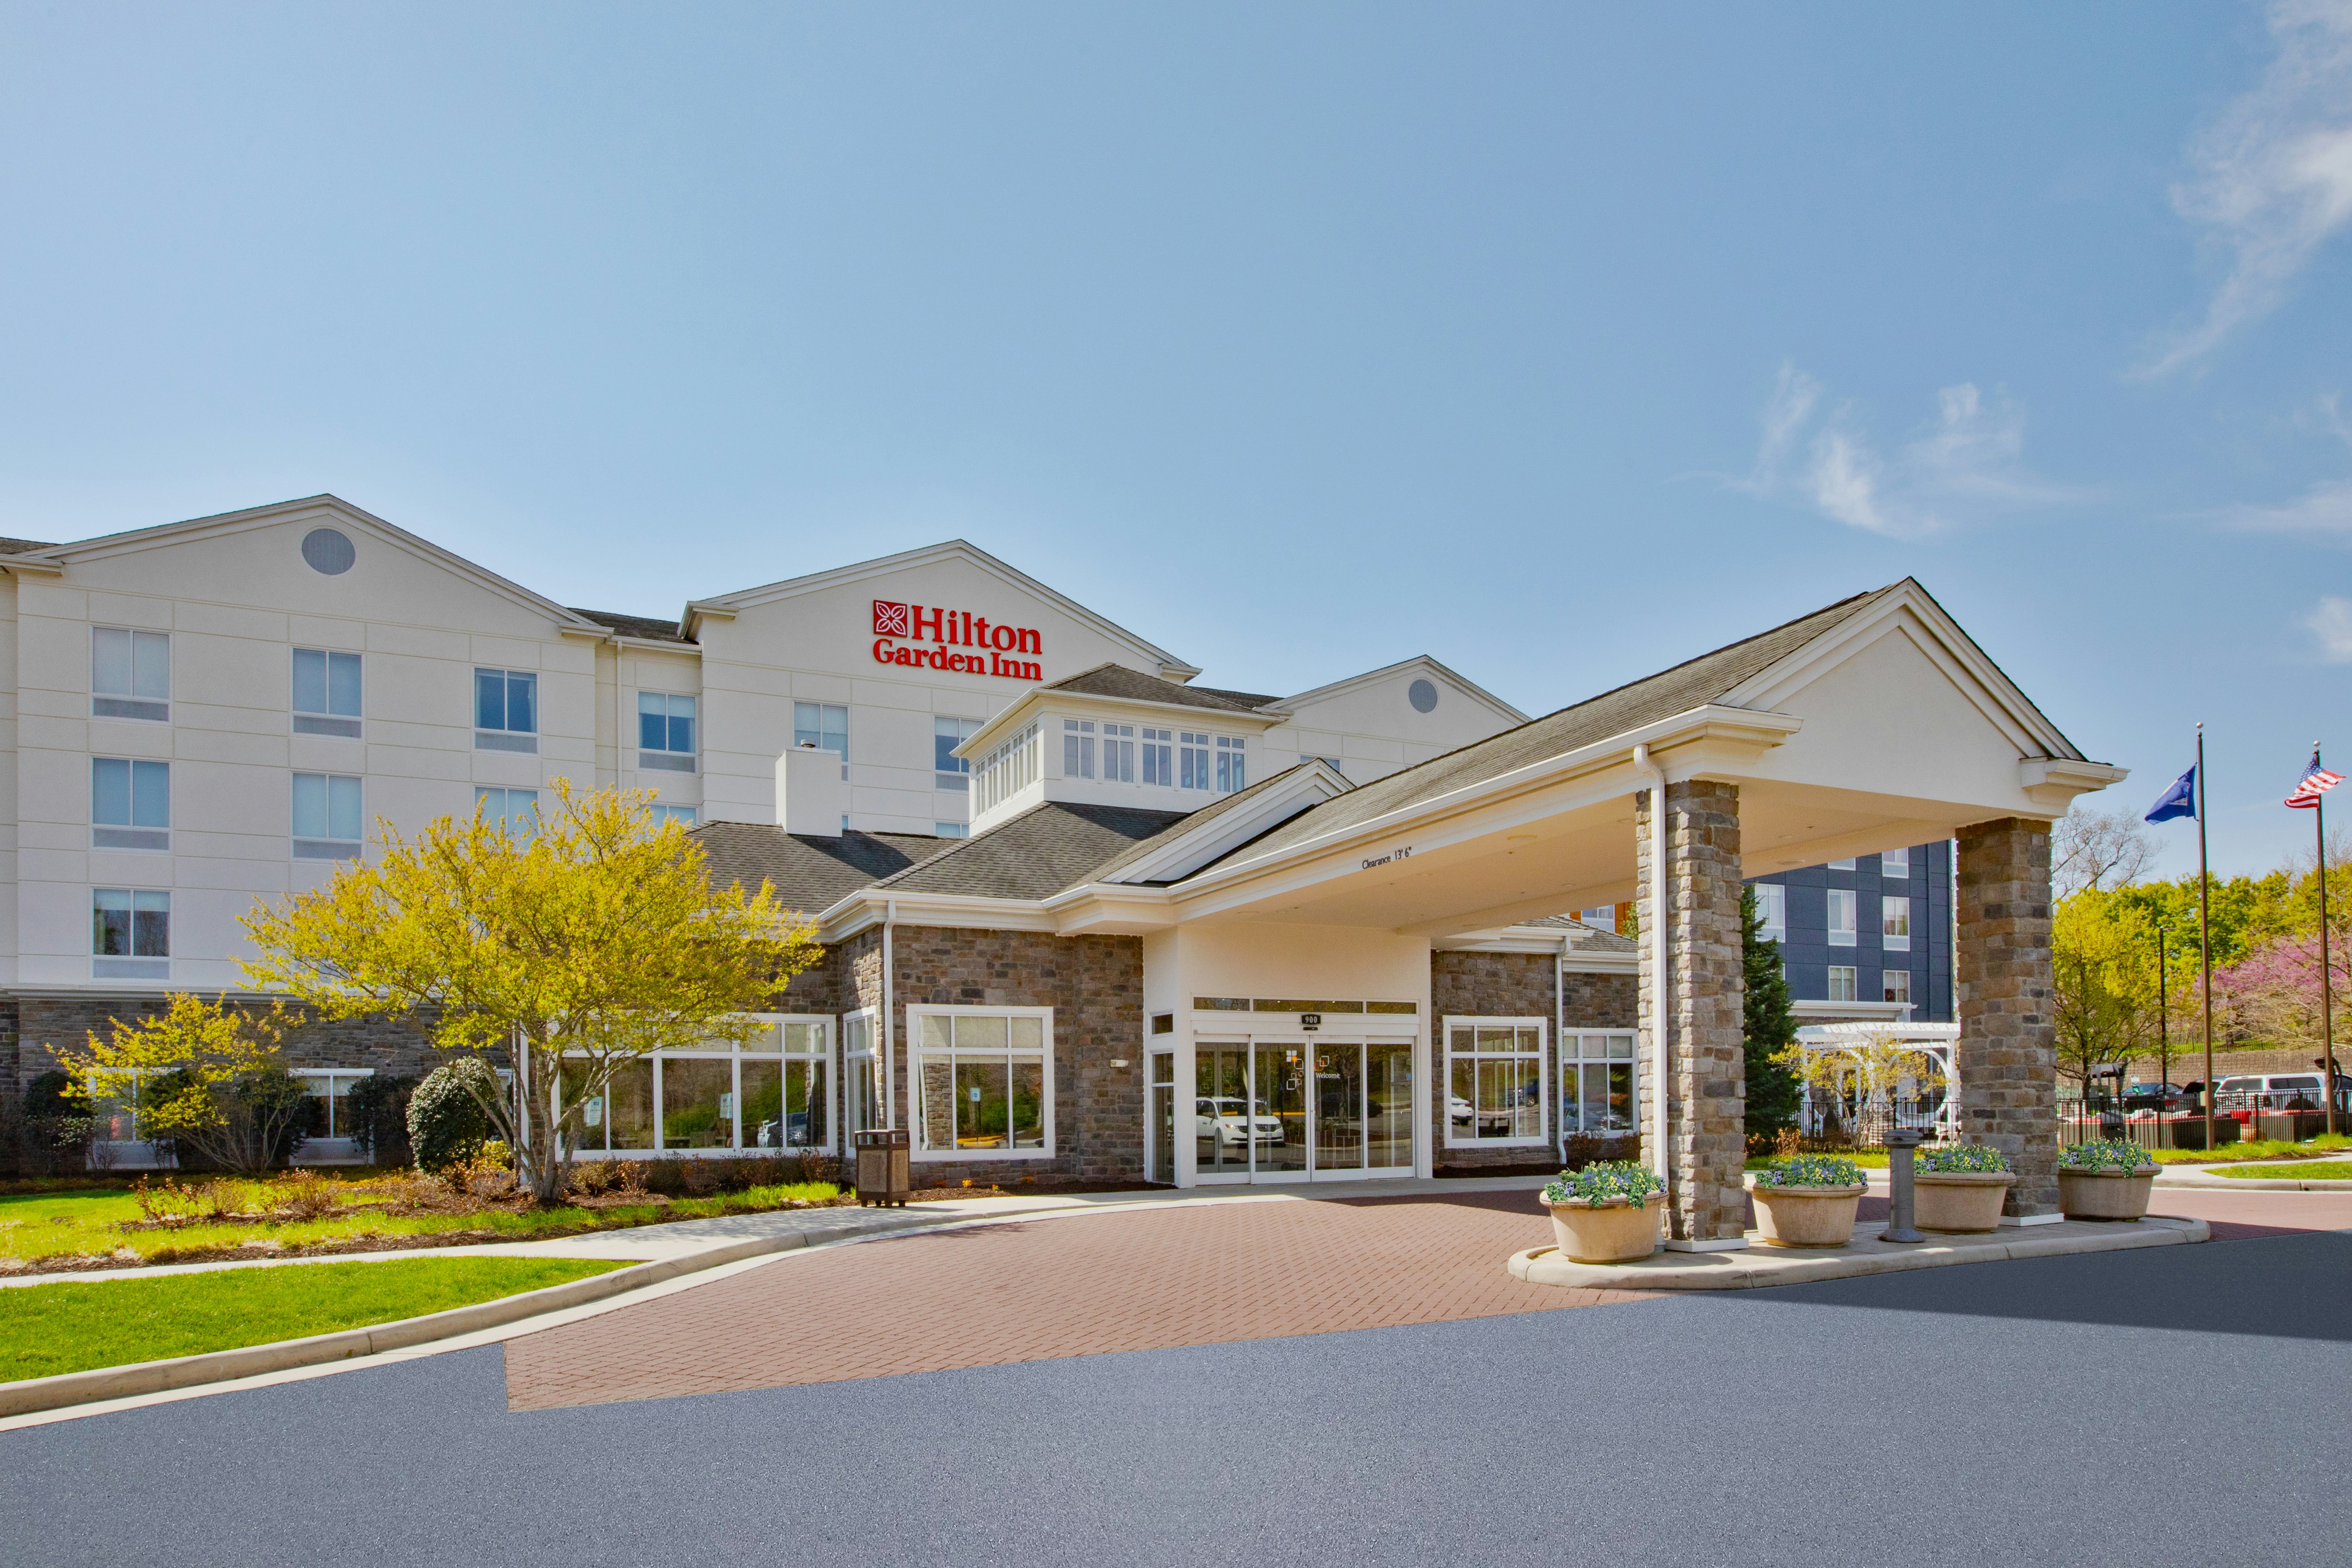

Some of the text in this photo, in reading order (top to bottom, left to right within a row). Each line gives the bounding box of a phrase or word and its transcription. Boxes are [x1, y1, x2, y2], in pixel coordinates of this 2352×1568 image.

[912, 605, 1043, 654] Hilton
[873, 638, 1043, 681] Garden Inn
[1362, 856, 1391, 870] Clearance
